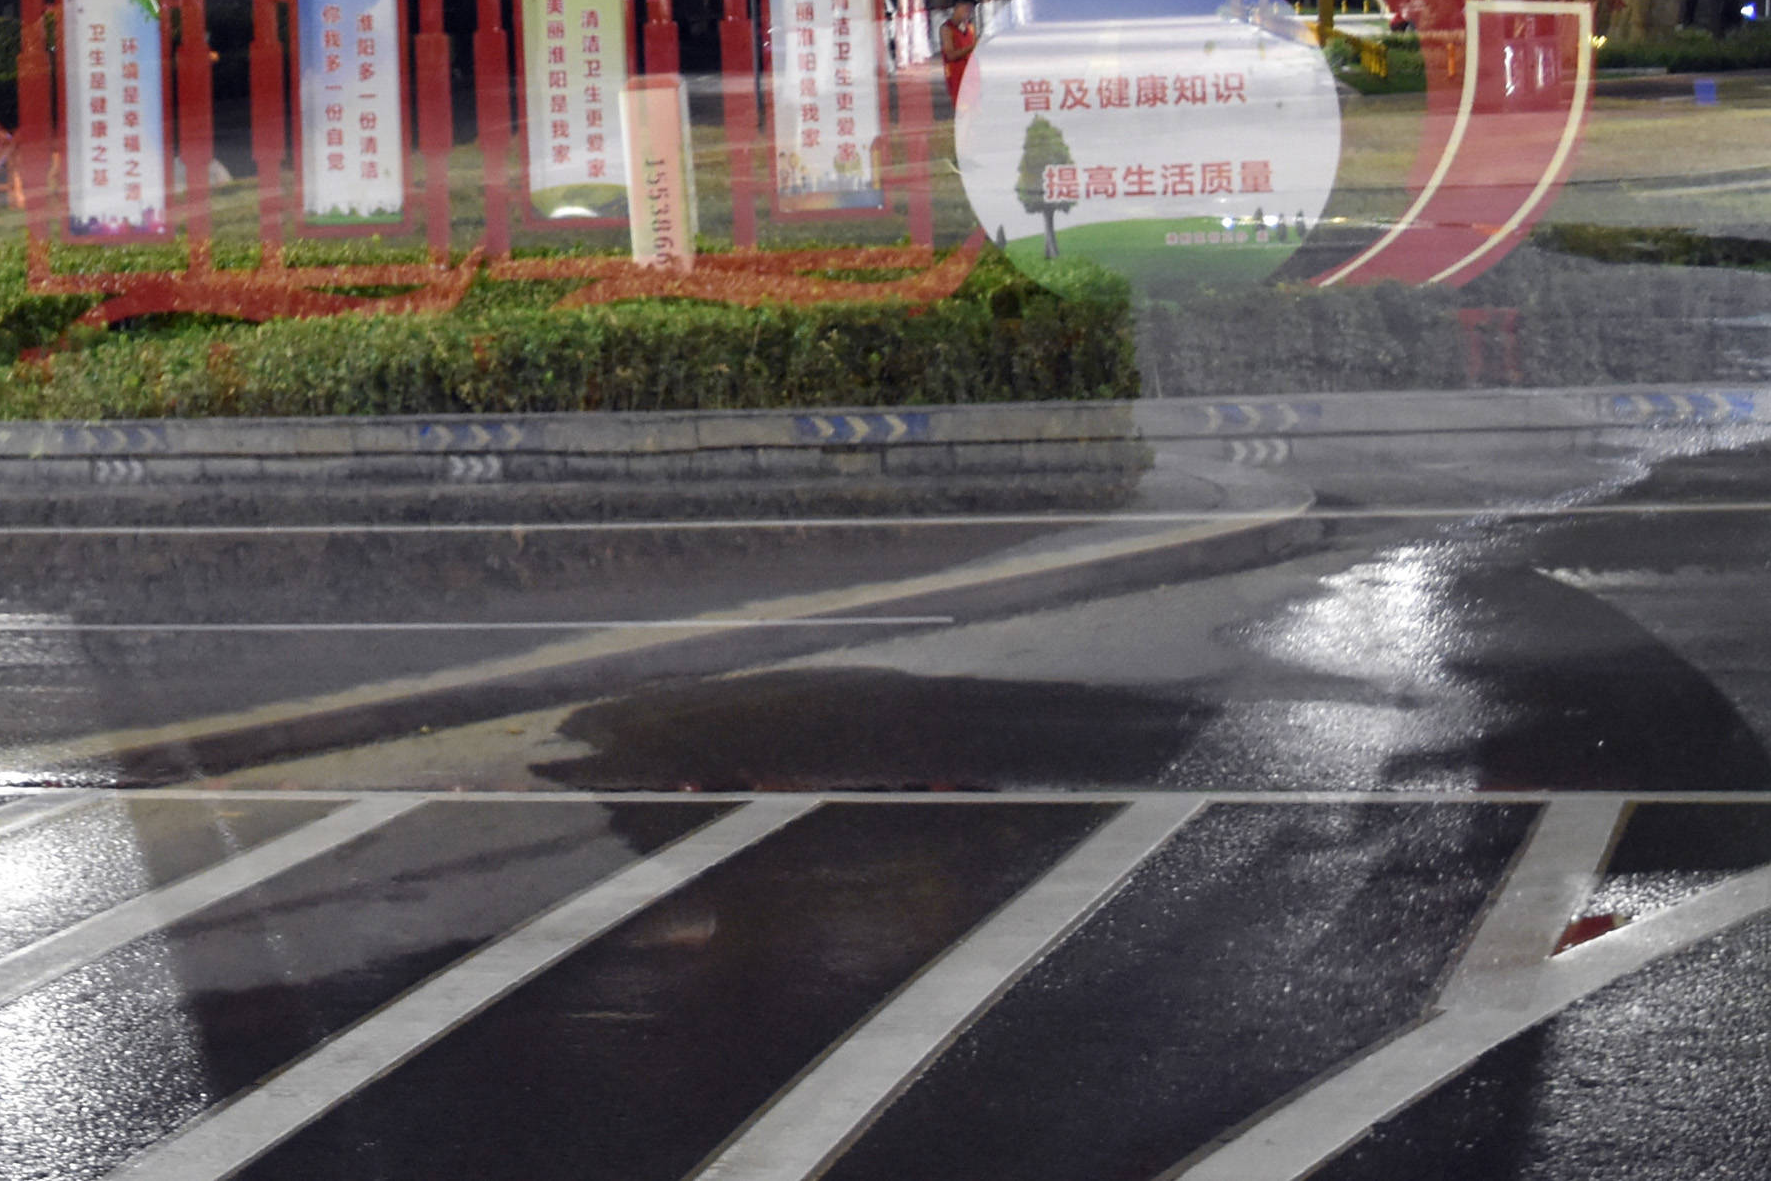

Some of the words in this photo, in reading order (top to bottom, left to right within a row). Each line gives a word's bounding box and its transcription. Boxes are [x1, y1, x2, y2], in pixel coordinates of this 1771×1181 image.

[89, 23, 108, 187] 卫生是健康之基
[322, 4, 345, 171] 你我多一份自觉
[356, 12, 379, 180] 淮阳多一份清洁
[581, 8, 606, 179] 清洁卫生更爱家
[1020, 72, 1247, 112] 普及健康知识
[1044, 160, 1274, 200] 提高生活质量
